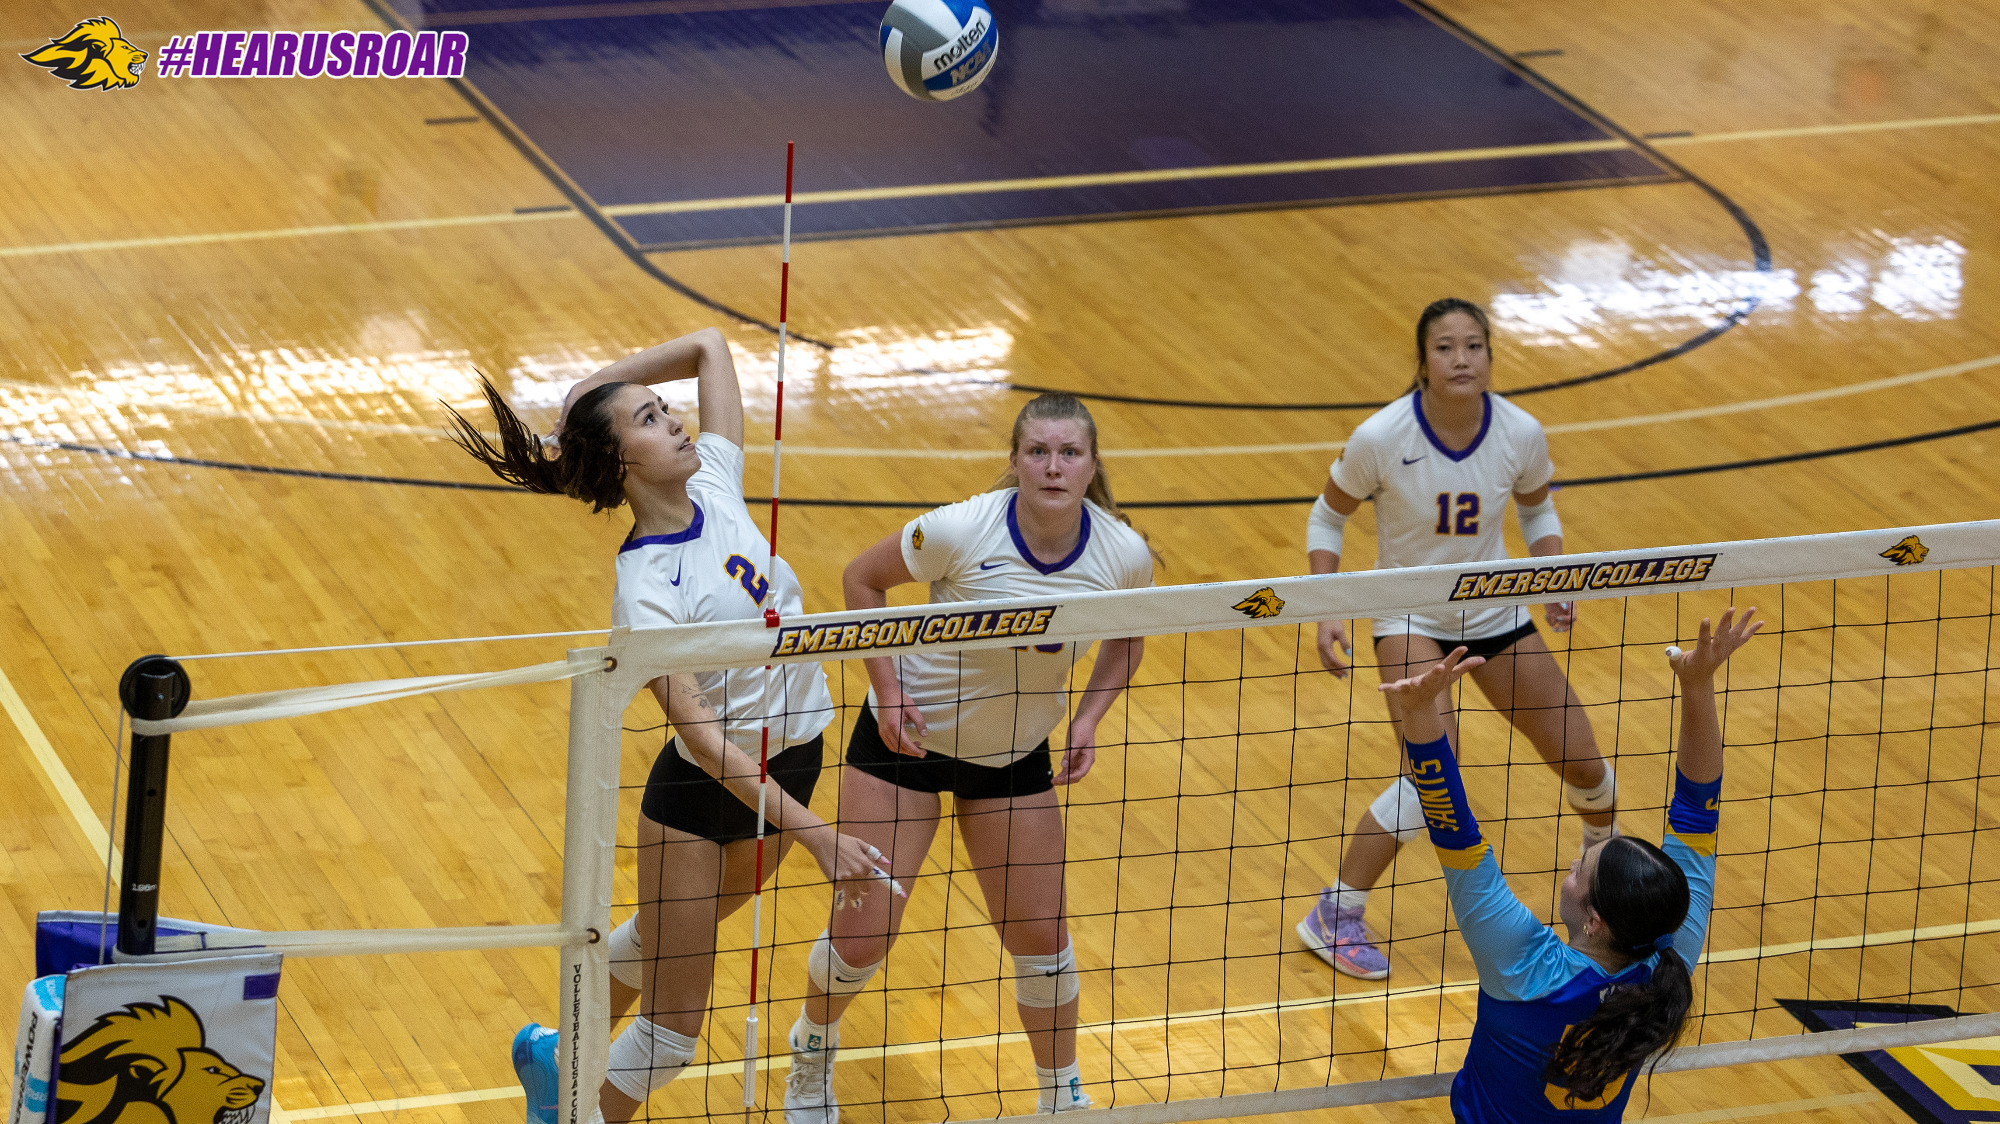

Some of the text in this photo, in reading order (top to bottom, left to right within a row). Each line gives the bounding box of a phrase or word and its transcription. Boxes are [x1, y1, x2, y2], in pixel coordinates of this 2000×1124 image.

[933, 18, 986, 71] molten
[950, 39, 992, 86] NCAA
[1434, 492, 1481, 536] 12
[723, 553, 769, 608] 2
[1453, 557, 1714, 599] EMERSON COLLEGE
[775, 608, 1053, 655] EMERSON COLLEGE
[1410, 758, 1459, 832] SAINTS
